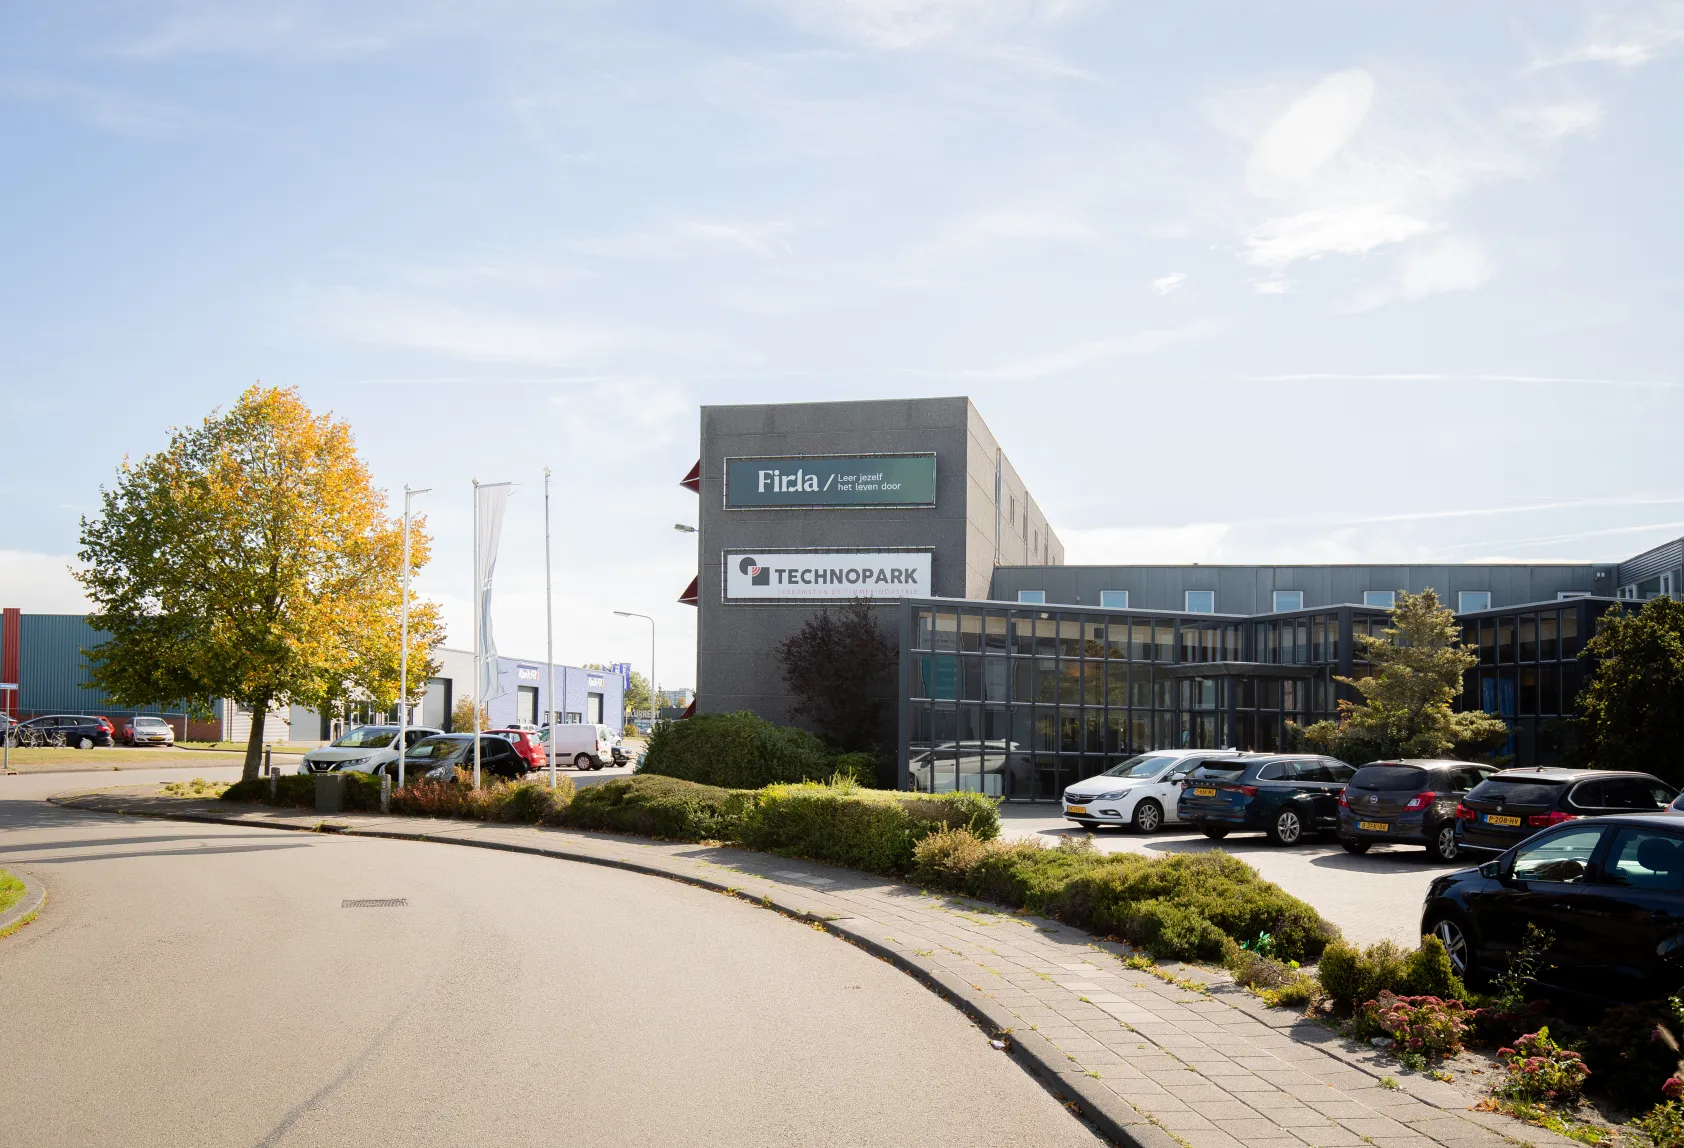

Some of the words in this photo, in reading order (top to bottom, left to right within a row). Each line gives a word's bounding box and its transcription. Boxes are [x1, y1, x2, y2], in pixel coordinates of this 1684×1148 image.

[758, 469, 819, 492] Firda
[838, 474, 857, 482] Leer
[859, 473, 883, 483] jezelf
[838, 483, 853, 491] het
[856, 483, 878, 491] leven
[881, 482, 901, 490] door
[775, 568, 918, 585] TECHNOPARK
